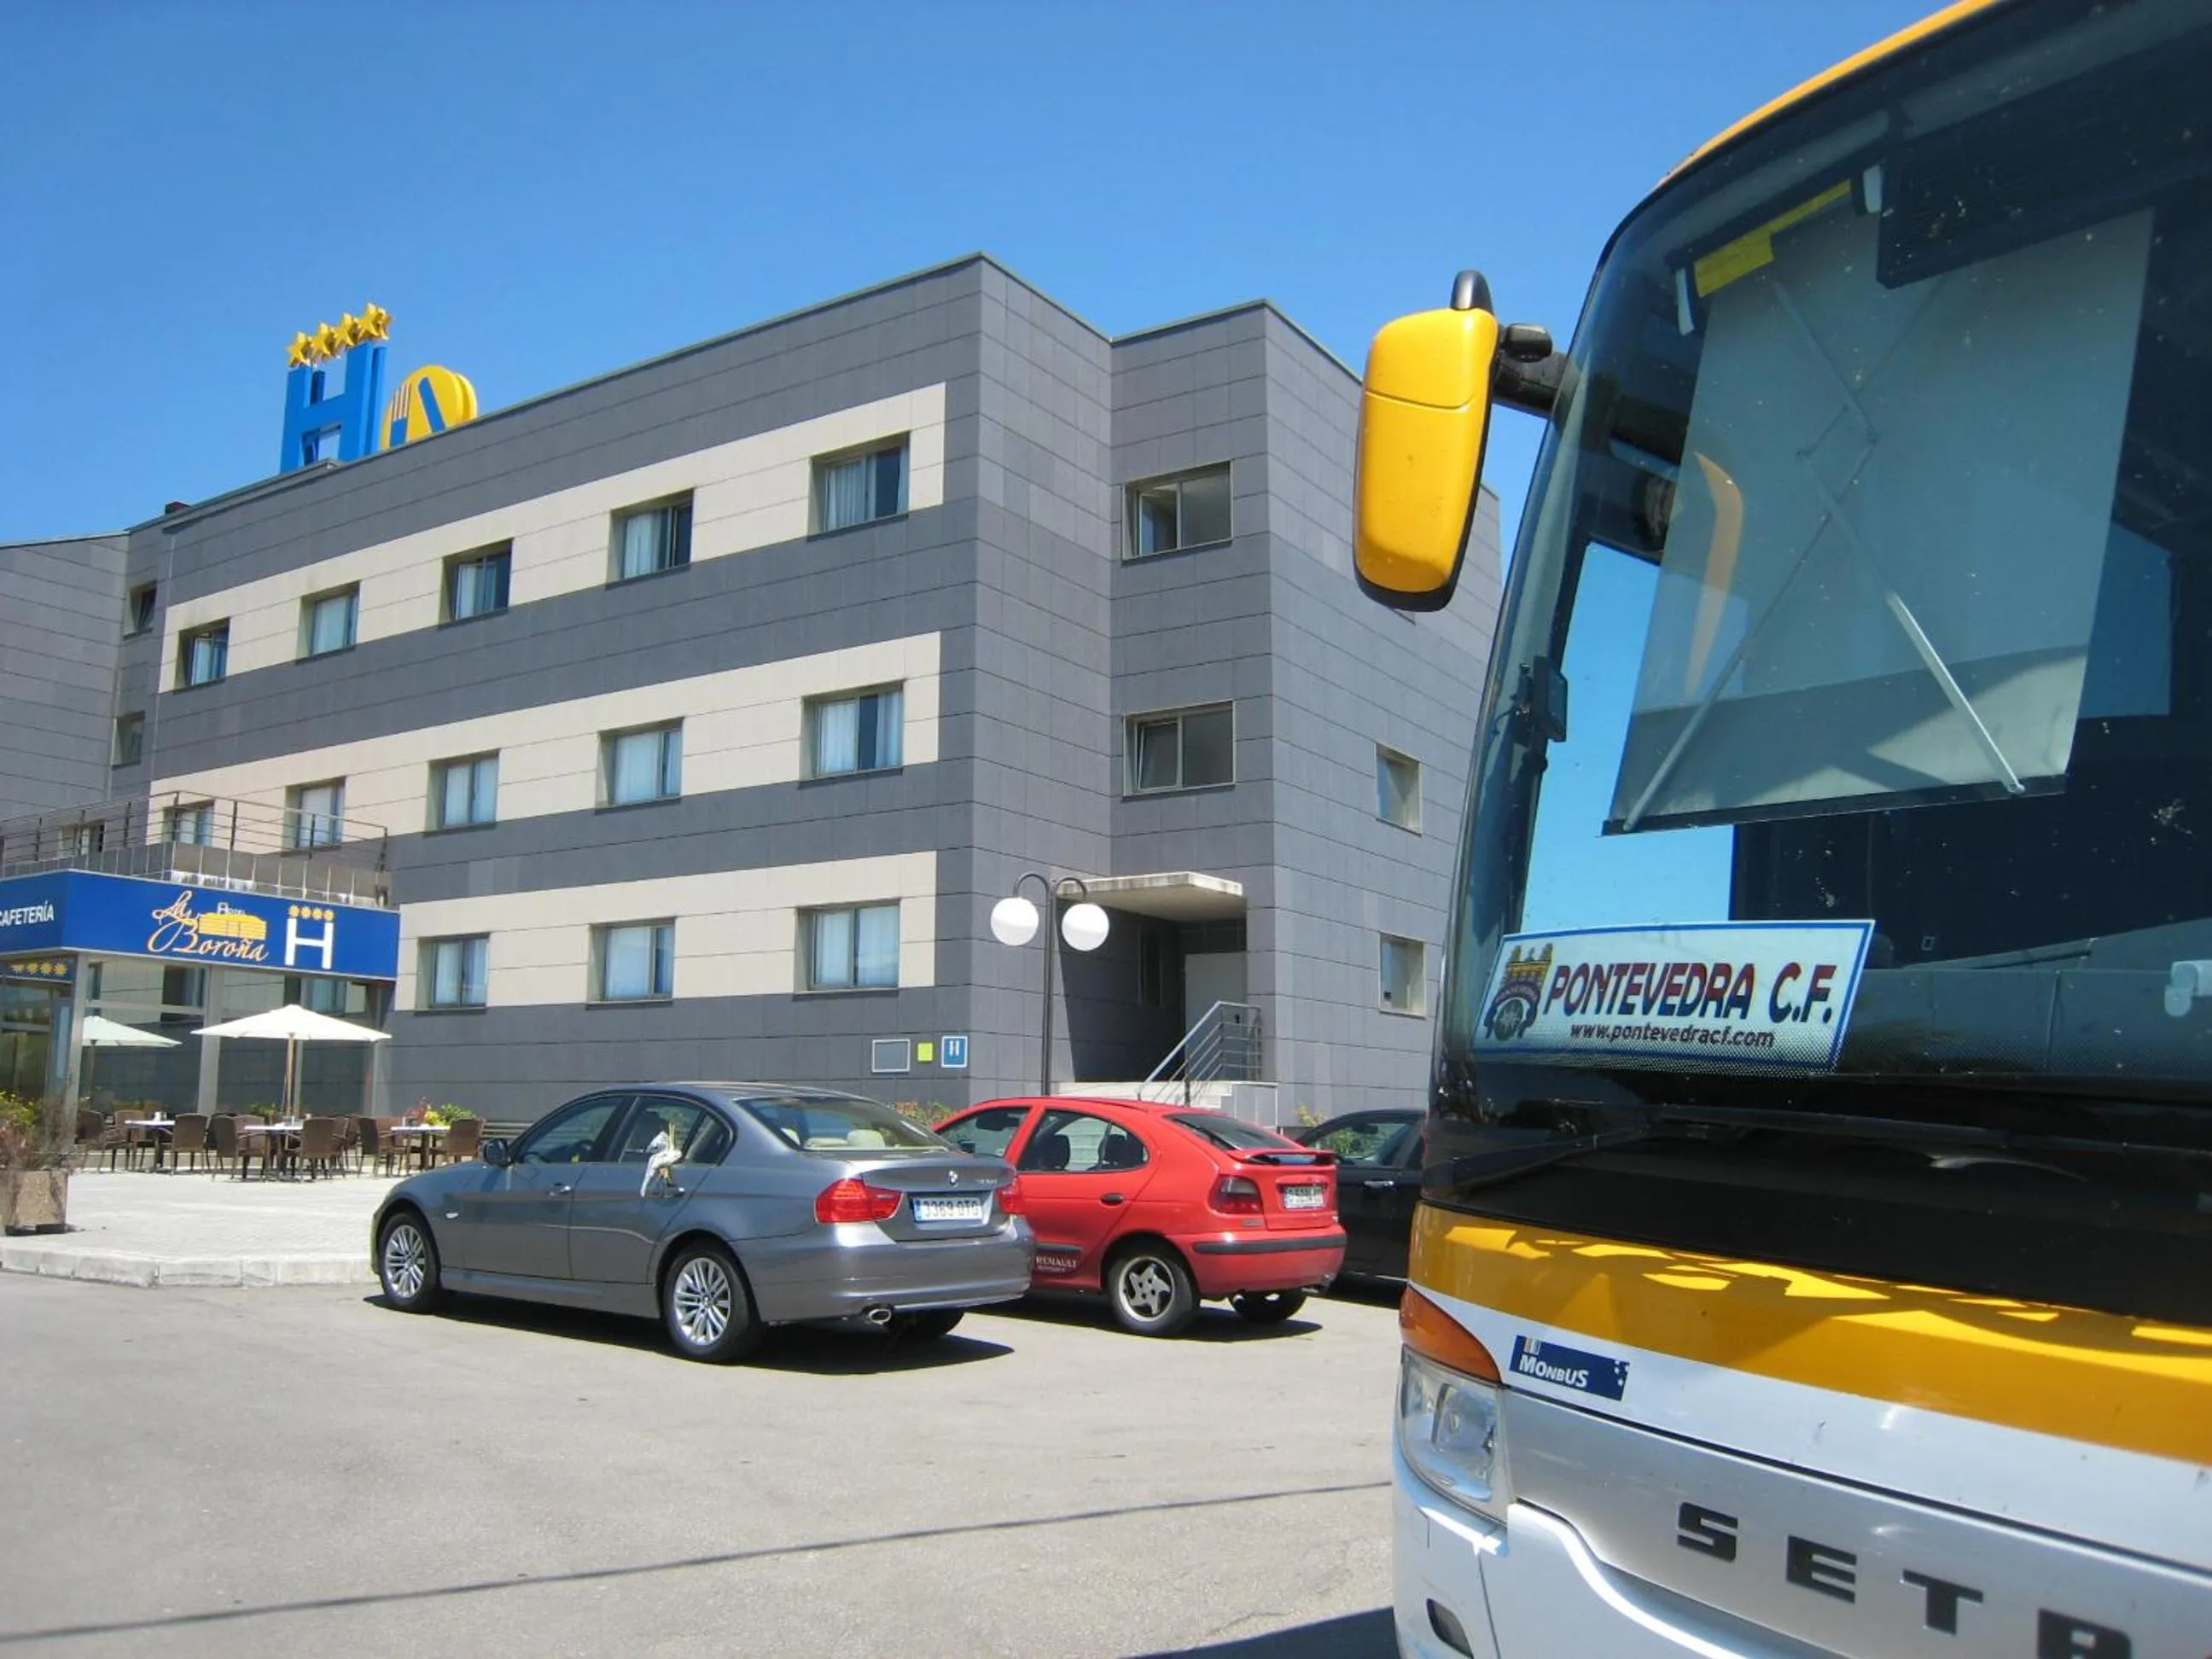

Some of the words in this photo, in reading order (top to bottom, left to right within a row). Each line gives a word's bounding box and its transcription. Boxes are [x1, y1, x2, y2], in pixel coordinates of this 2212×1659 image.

[284, 917, 335, 970] H
[1543, 963, 1755, 1020] PONTEVEDRA
[1768, 961, 1837, 1023] C.F.
[1570, 1022, 1775, 1048] www.pontevedracf.com
[1677, 1501, 2212, 1659] SETR
